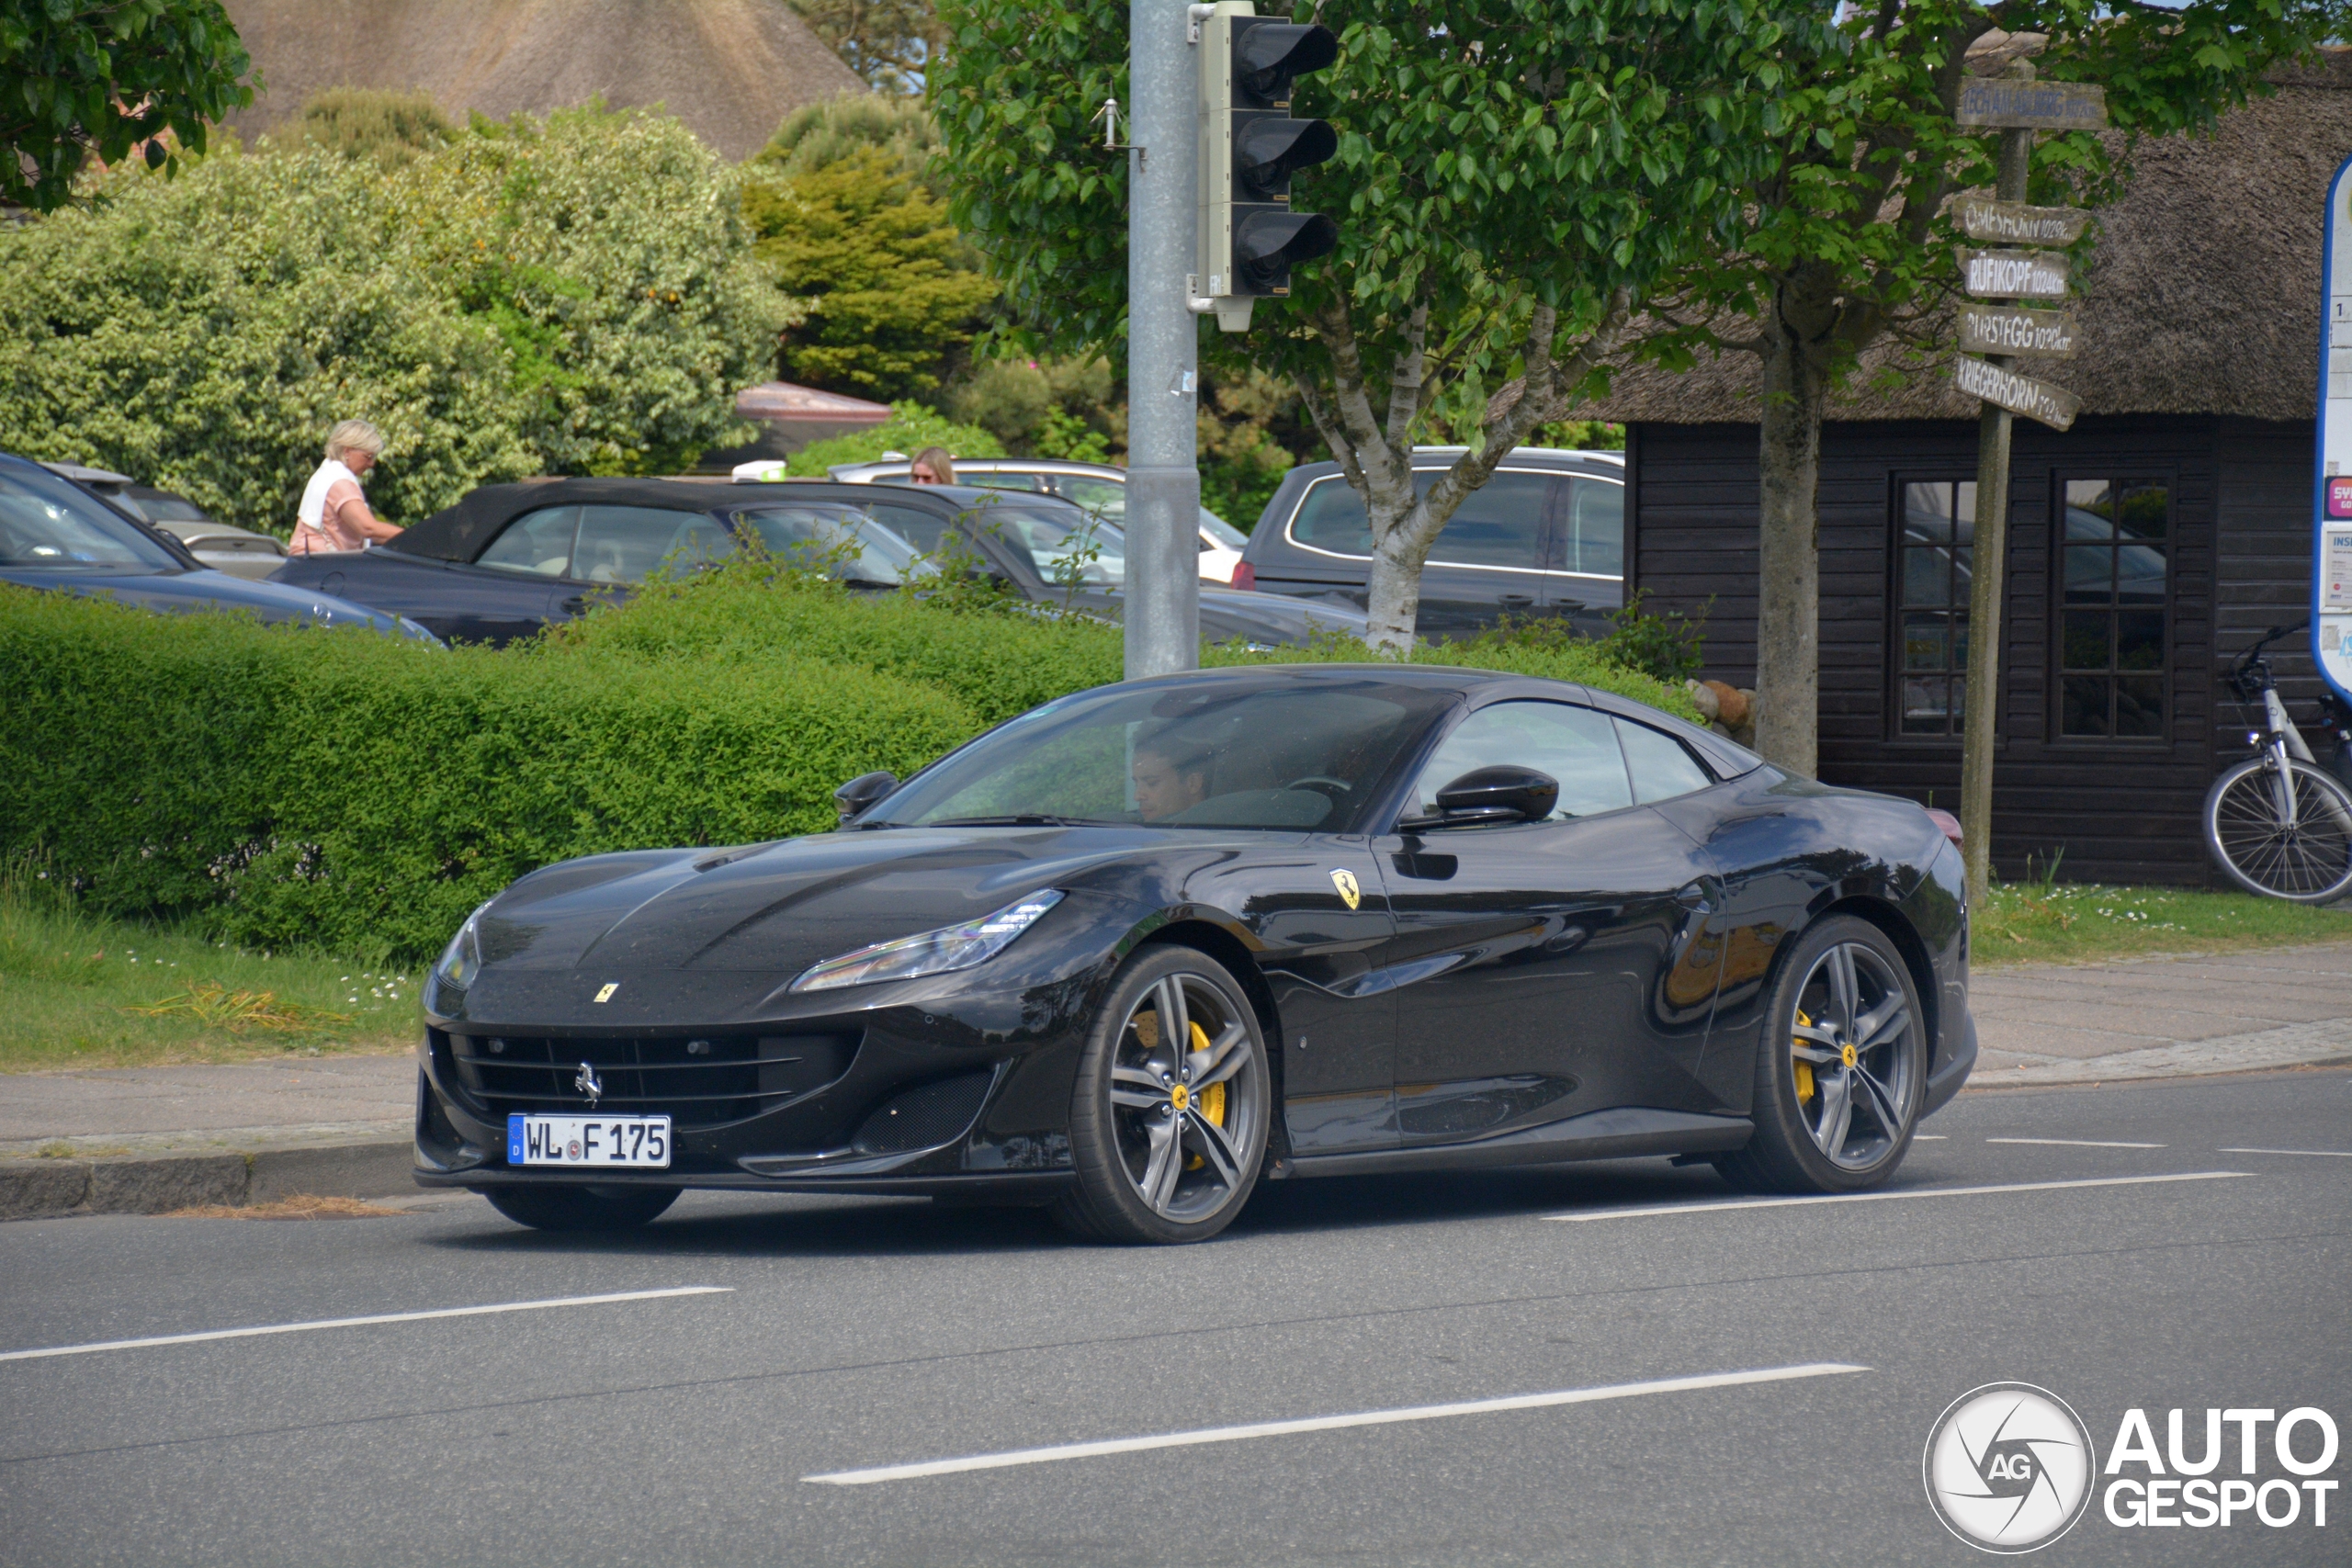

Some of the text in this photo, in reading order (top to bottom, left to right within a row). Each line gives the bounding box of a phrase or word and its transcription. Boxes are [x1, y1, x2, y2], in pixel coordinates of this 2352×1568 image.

[1970, 251, 2032, 292] RÜFIKOPF
[1958, 356, 2040, 412] KRIEGERHORN
[513, 1145, 520, 1156] D
[526, 1122, 665, 1161] WL F 175
